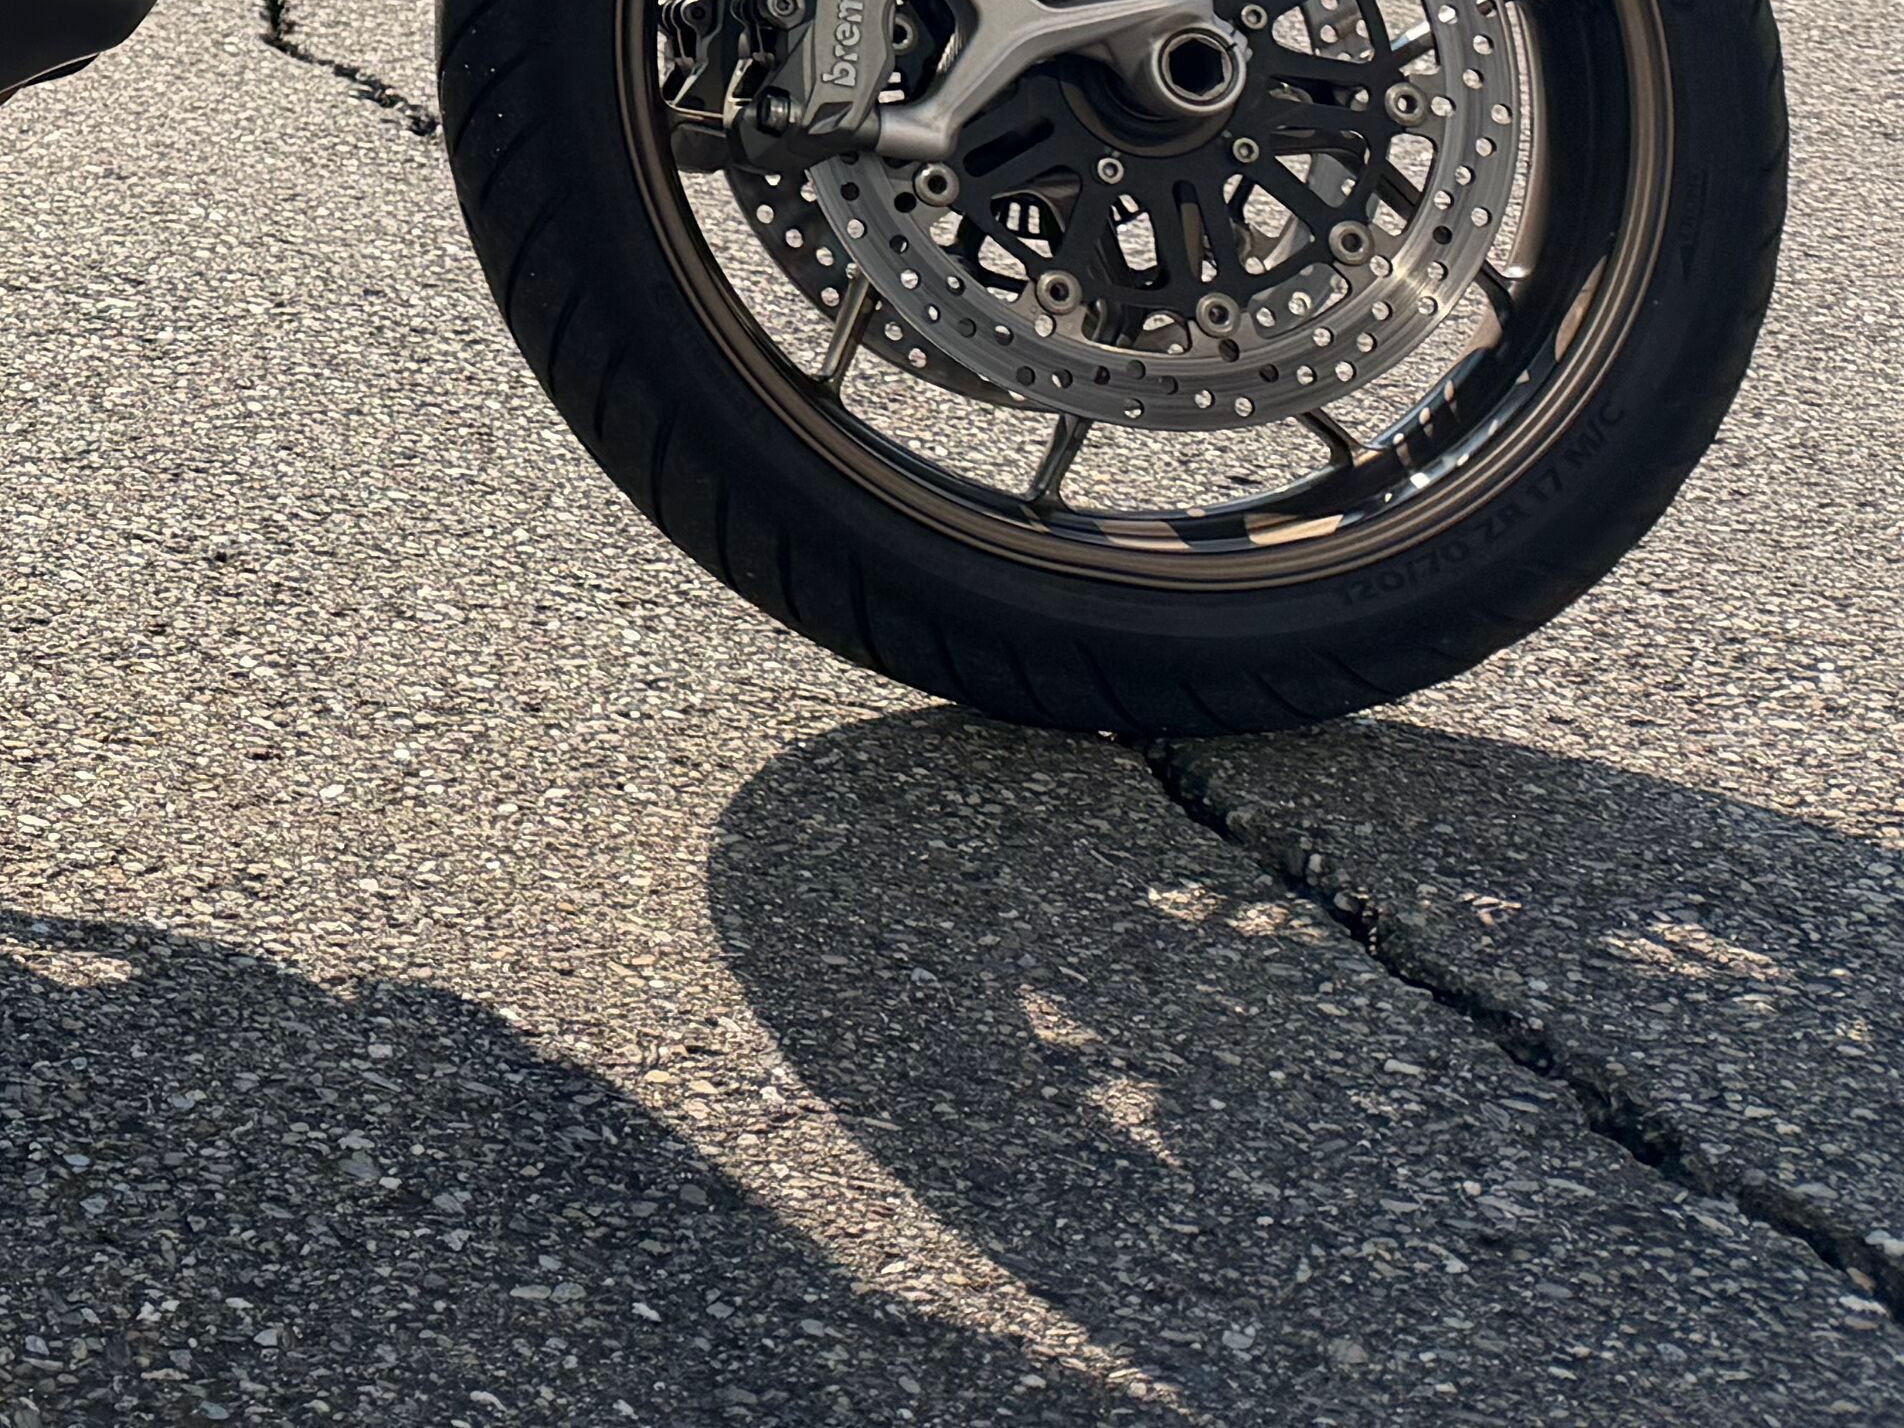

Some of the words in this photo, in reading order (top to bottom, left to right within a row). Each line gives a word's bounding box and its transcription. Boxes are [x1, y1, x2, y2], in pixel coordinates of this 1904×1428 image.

[1339, 537, 1472, 606] 120/70
[1483, 496, 1531, 545] ZR
[1525, 465, 1565, 505] 17
[1564, 400, 1626, 476] M/C
